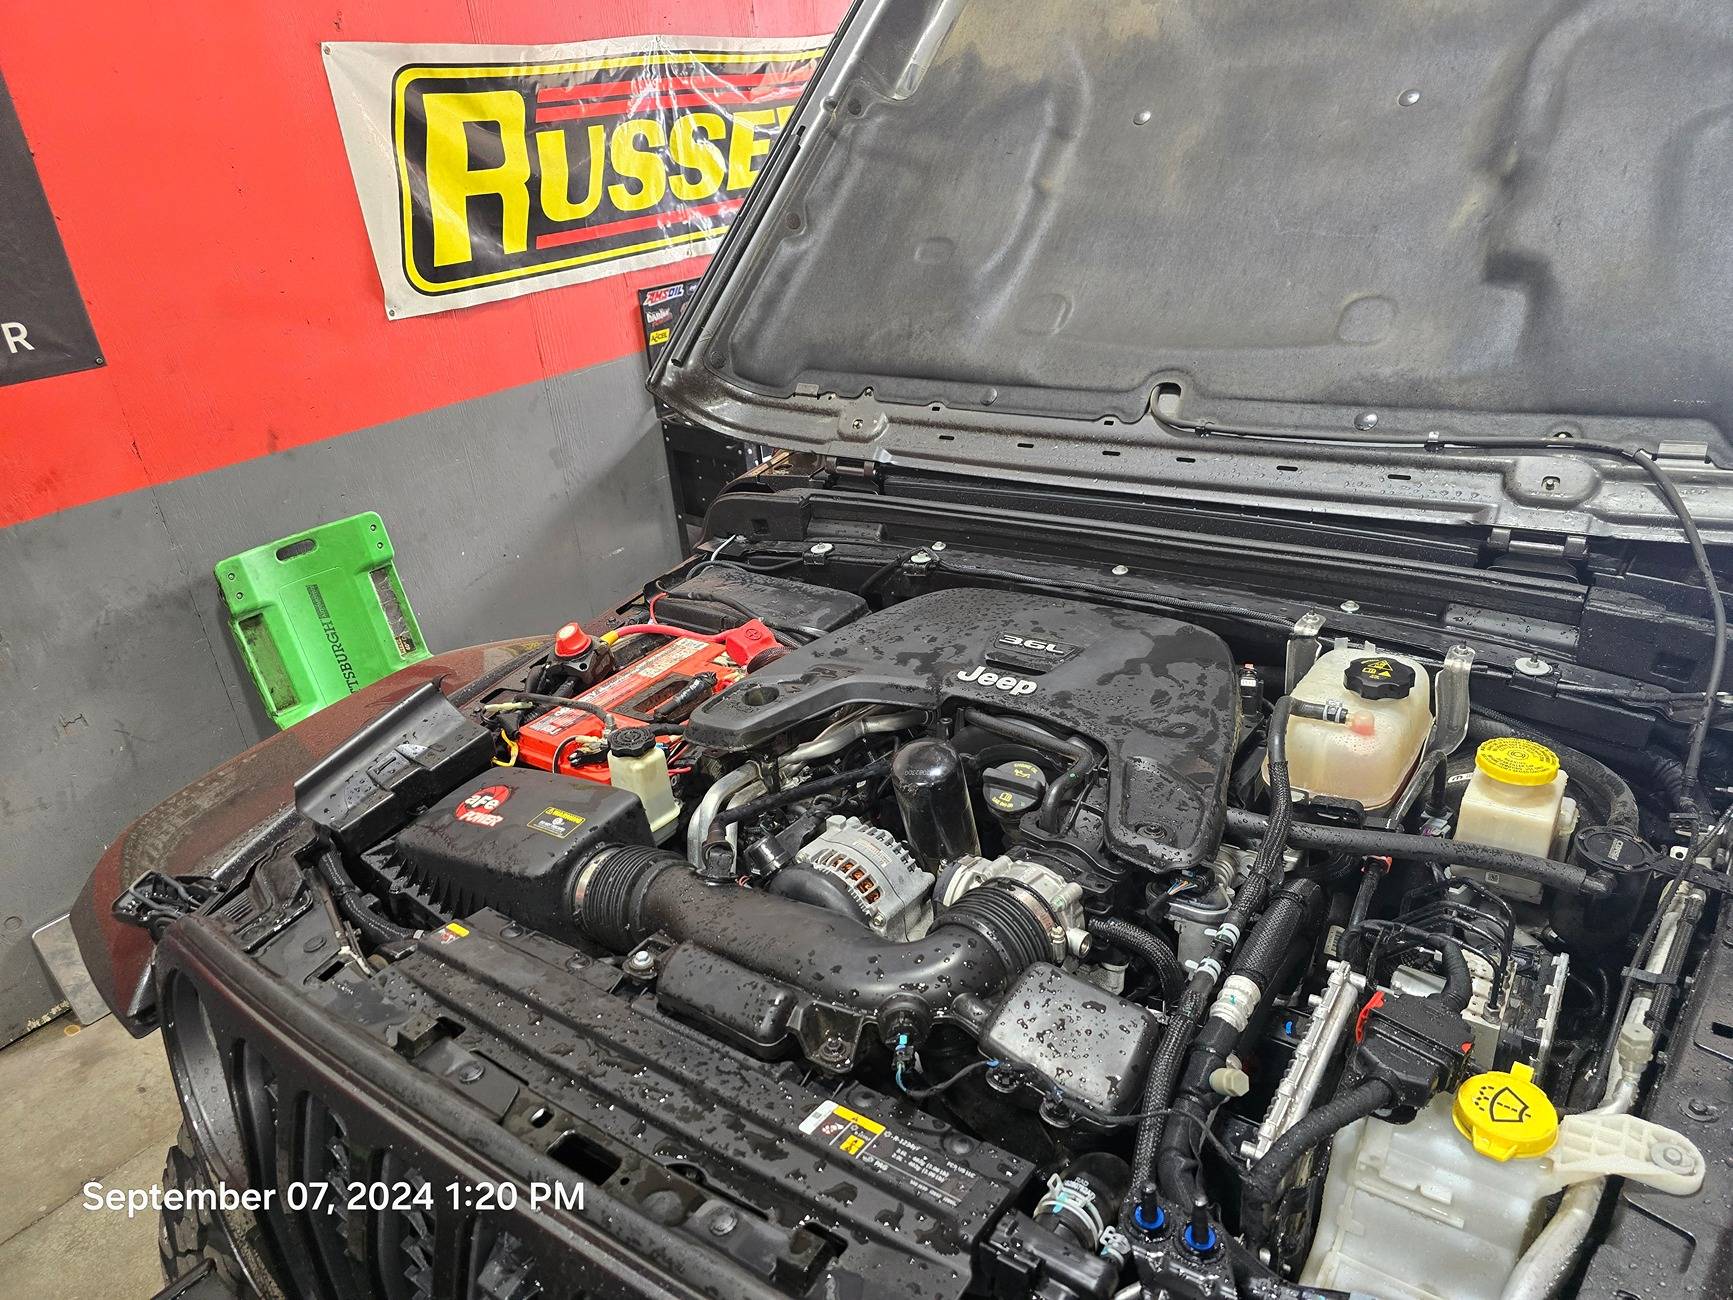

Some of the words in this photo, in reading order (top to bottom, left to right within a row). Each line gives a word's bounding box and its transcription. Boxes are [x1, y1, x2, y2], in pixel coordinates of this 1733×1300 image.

[643, 284, 685, 306] AMSOIL
[999, 634, 1065, 655] 3.6L
[957, 665, 1038, 696] Jeep
[464, 794, 499, 810] aFe
